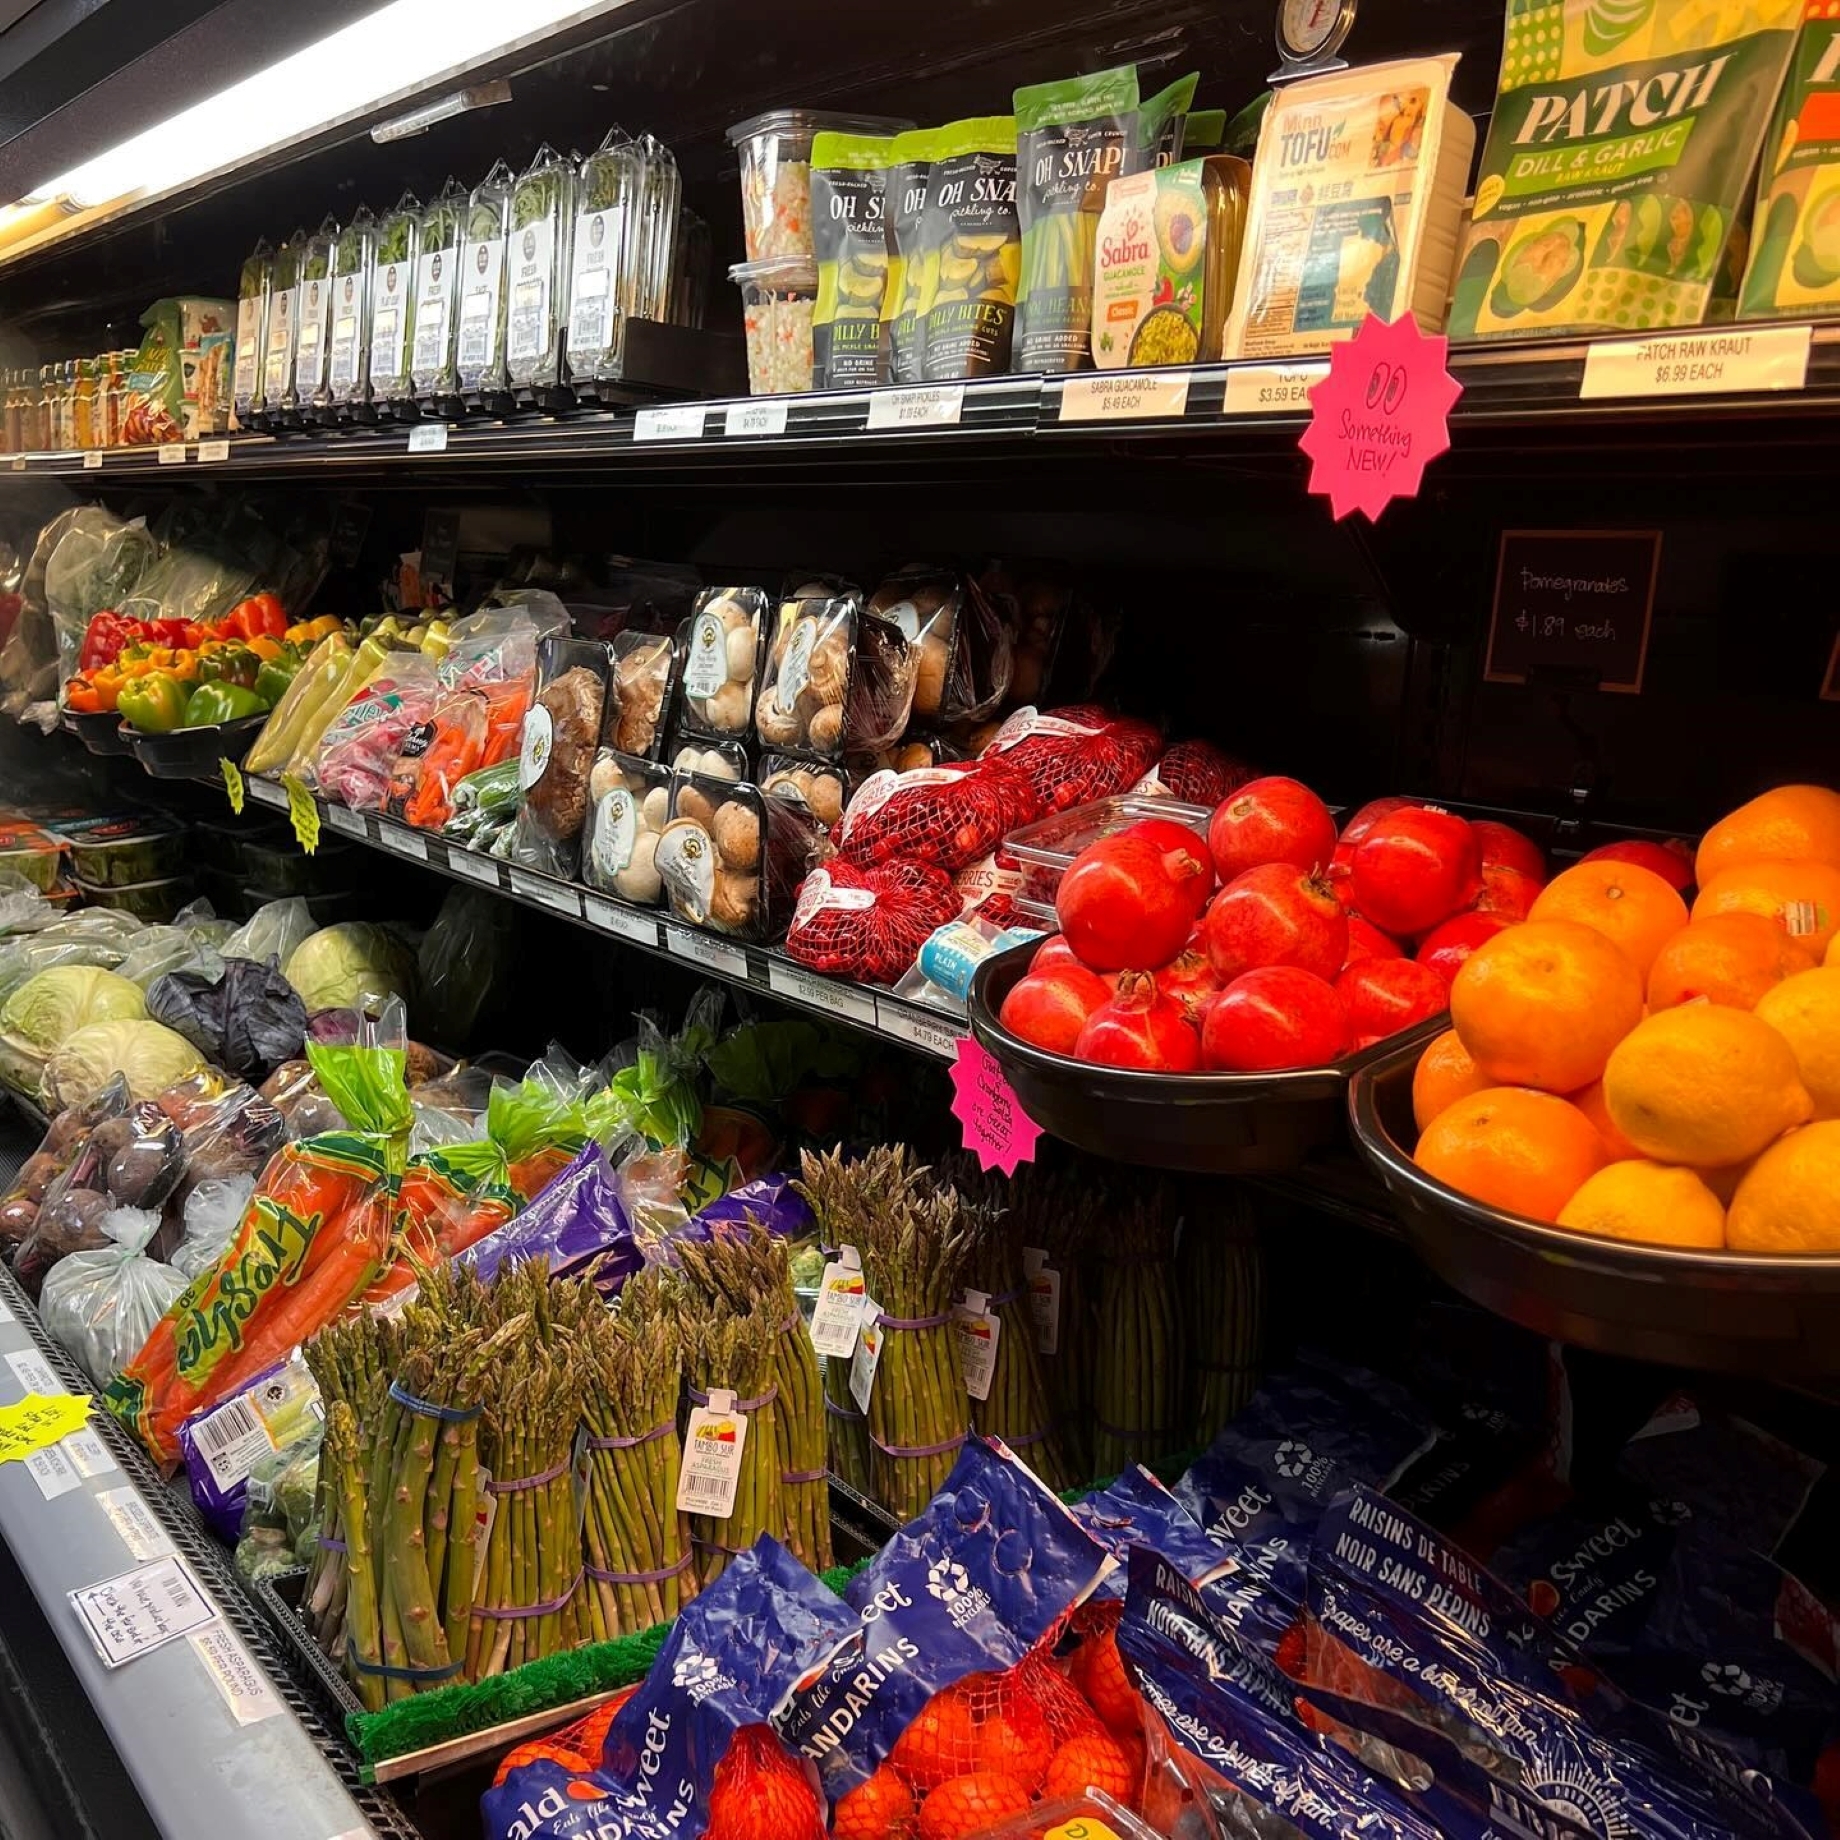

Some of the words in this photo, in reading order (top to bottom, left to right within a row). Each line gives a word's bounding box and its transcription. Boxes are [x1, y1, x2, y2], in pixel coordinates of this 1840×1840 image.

[1510, 52, 1738, 145] PATCH
[1280, 126, 1331, 167] TOFU
[1515, 152, 1562, 178] DILL
[1569, 149, 1588, 168] &
[1593, 126, 1683, 164] GARLIC
[1036, 155, 1053, 186] OH
[1059, 147, 1126, 177] SNAP!
[830, 195, 857, 220] OH
[904, 188, 927, 214] OH
[938, 180, 965, 207] OH
[970, 177, 1017, 203] SNA
[1101, 237, 1149, 267] Sabra
[958, 304, 1004, 325] BITES
[1679, 342, 1707, 359] RAW
[1709, 337, 1752, 356] KRAUT
[1091, 381, 1113, 393] SABRA
[1114, 378, 1157, 392] GUACAMOLE
[1655, 365, 1687, 383] $6.99
[1689, 363, 1724, 381] EACH
[1121, 396, 1141, 408] EACH
[1258, 388, 1287, 402] $3.59
[1291, 387, 1310, 401] EA
[1339, 408, 1412, 458] Something
[1346, 447, 1397, 478] NEW!
[1520, 566, 1630, 601] Pomegranates
[1515, 609, 1565, 637] $1.89
[956, 870, 993, 888] ERRIES
[934, 952, 957, 970] PLAIN
[816, 990, 829, 1002] PER
[830, 996, 844, 1008] BAG
[933, 1034, 954, 1051] EACH
[694, 1439, 719, 1452] TAMBO
[721, 1443, 734, 1456] SUR
[1302, 1456, 1328, 1489] 100%
[1205, 1485, 1272, 1548] weet
[1349, 1497, 1413, 1551] RAISINS
[1417, 1533, 1436, 1566] DE
[1441, 1548, 1483, 1596] TABLE
[1549, 1515, 1644, 1592] Sweet
[1335, 1532, 1377, 1574] NOIR
[1377, 1556, 1426, 1600] SANS
[861, 1580, 913, 1623] eet
[946, 1585, 985, 1620] 100%
[1147, 1599, 1177, 1640] NOIR
[214, 1629, 235, 1654] FRESH
[226, 1652, 263, 1696] ASPARAGUS
[1372, 1634, 1404, 1661] are
[1403, 1656, 1420, 1672] a
[222, 1670, 244, 1696] POUND
[800, 1637, 921, 1760] ANDARINS
[1176, 1711, 1209, 1740] are
[1209, 1734, 1226, 1752] a
[507, 1787, 569, 1840] ald
[571, 1778, 696, 1840] NDARINS
